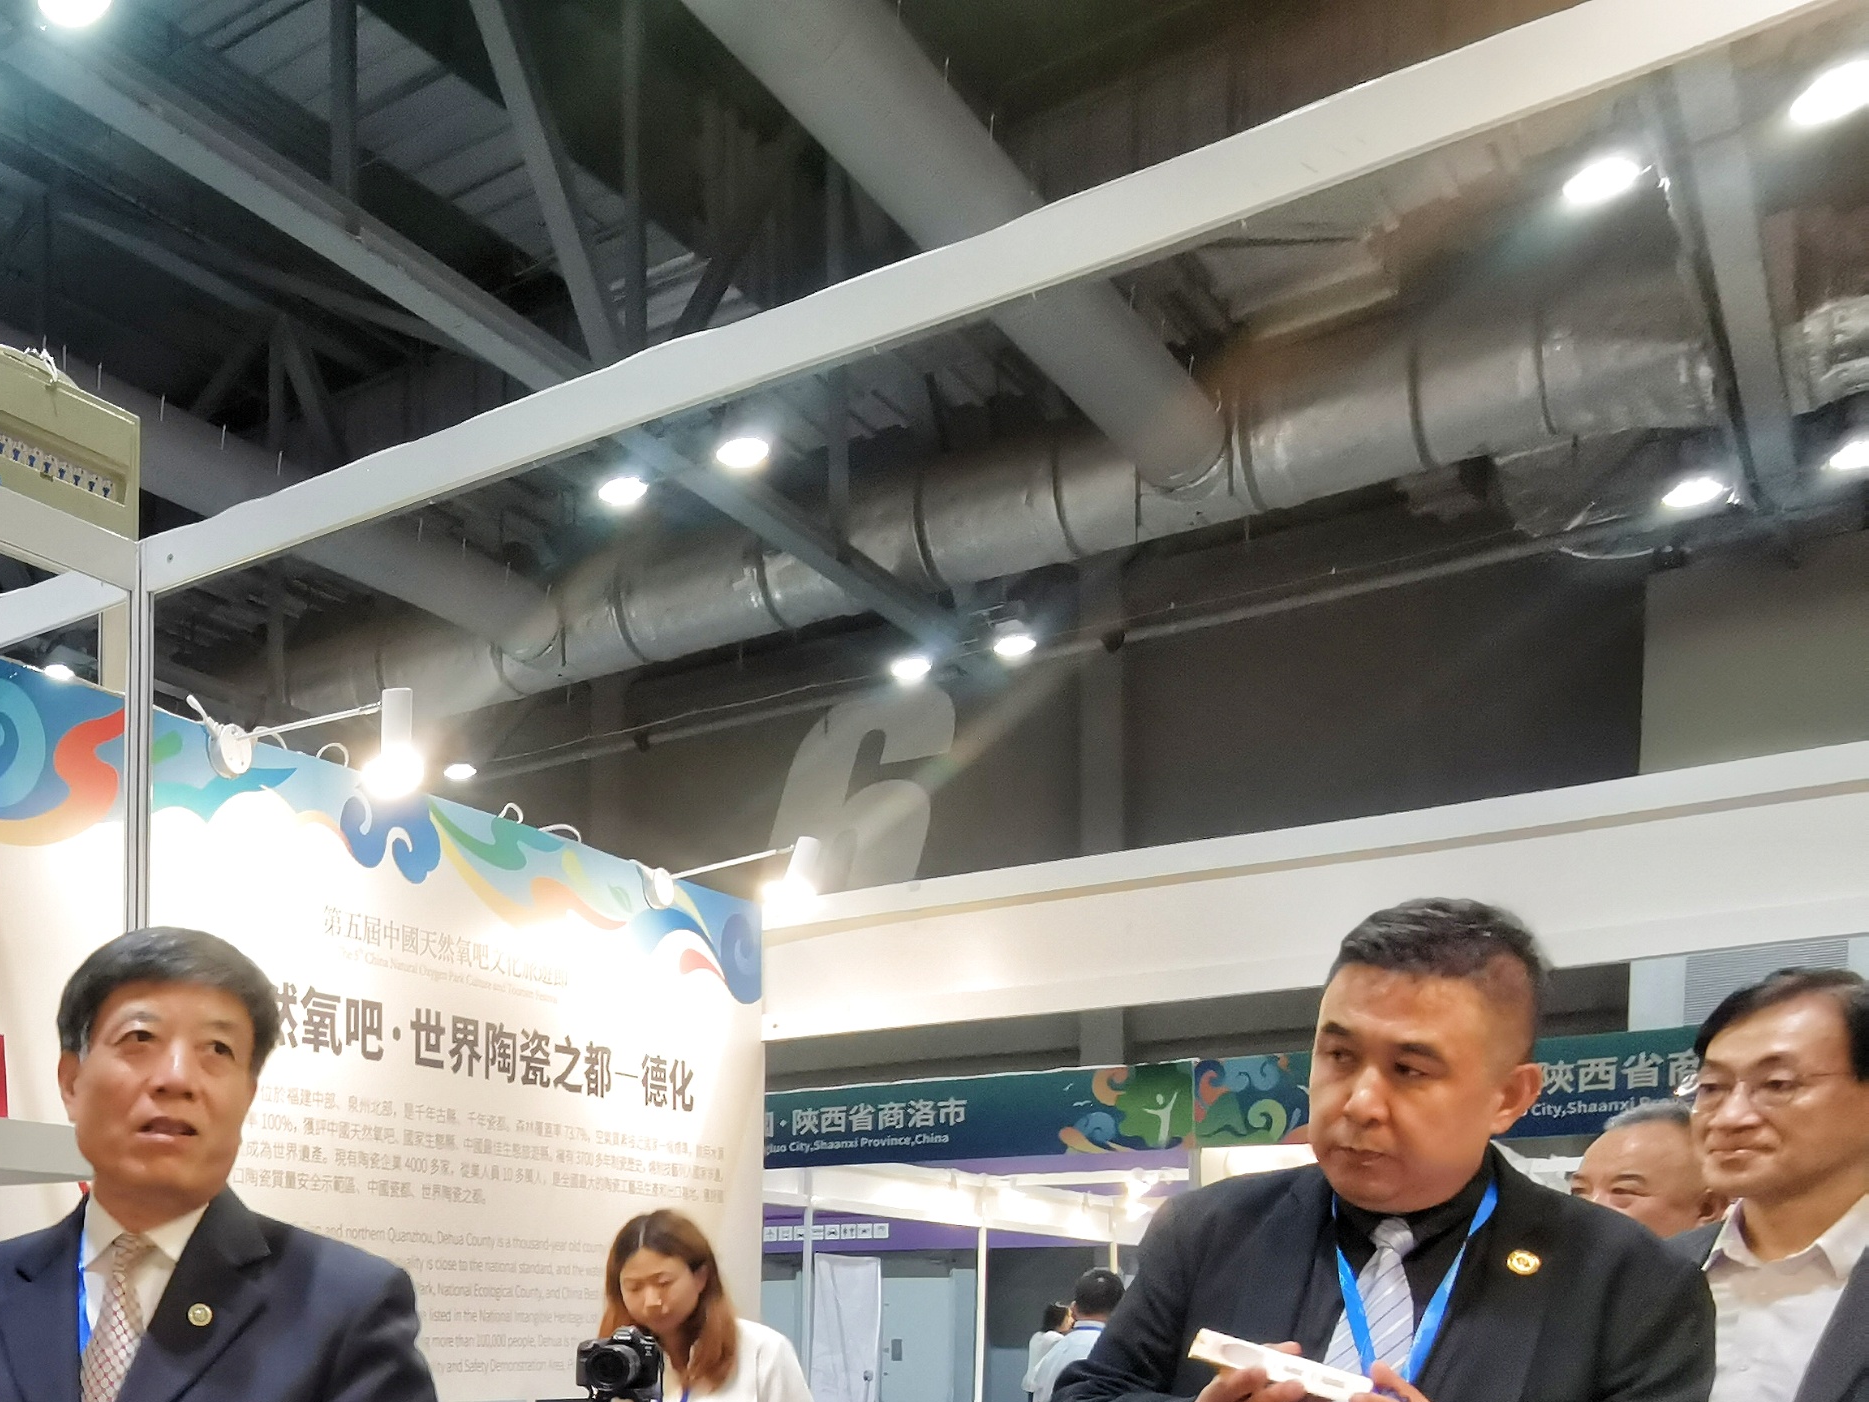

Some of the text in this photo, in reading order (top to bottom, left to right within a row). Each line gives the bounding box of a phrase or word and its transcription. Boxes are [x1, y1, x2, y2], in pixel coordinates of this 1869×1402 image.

[767, 684, 956, 890] 6
[764, 1097, 968, 1138] ·陝西省商洛市
[345, 1225, 385, 1240] northern
[388, 1226, 435, 1244] Quanzhou,
[466, 1232, 495, 1250] County
